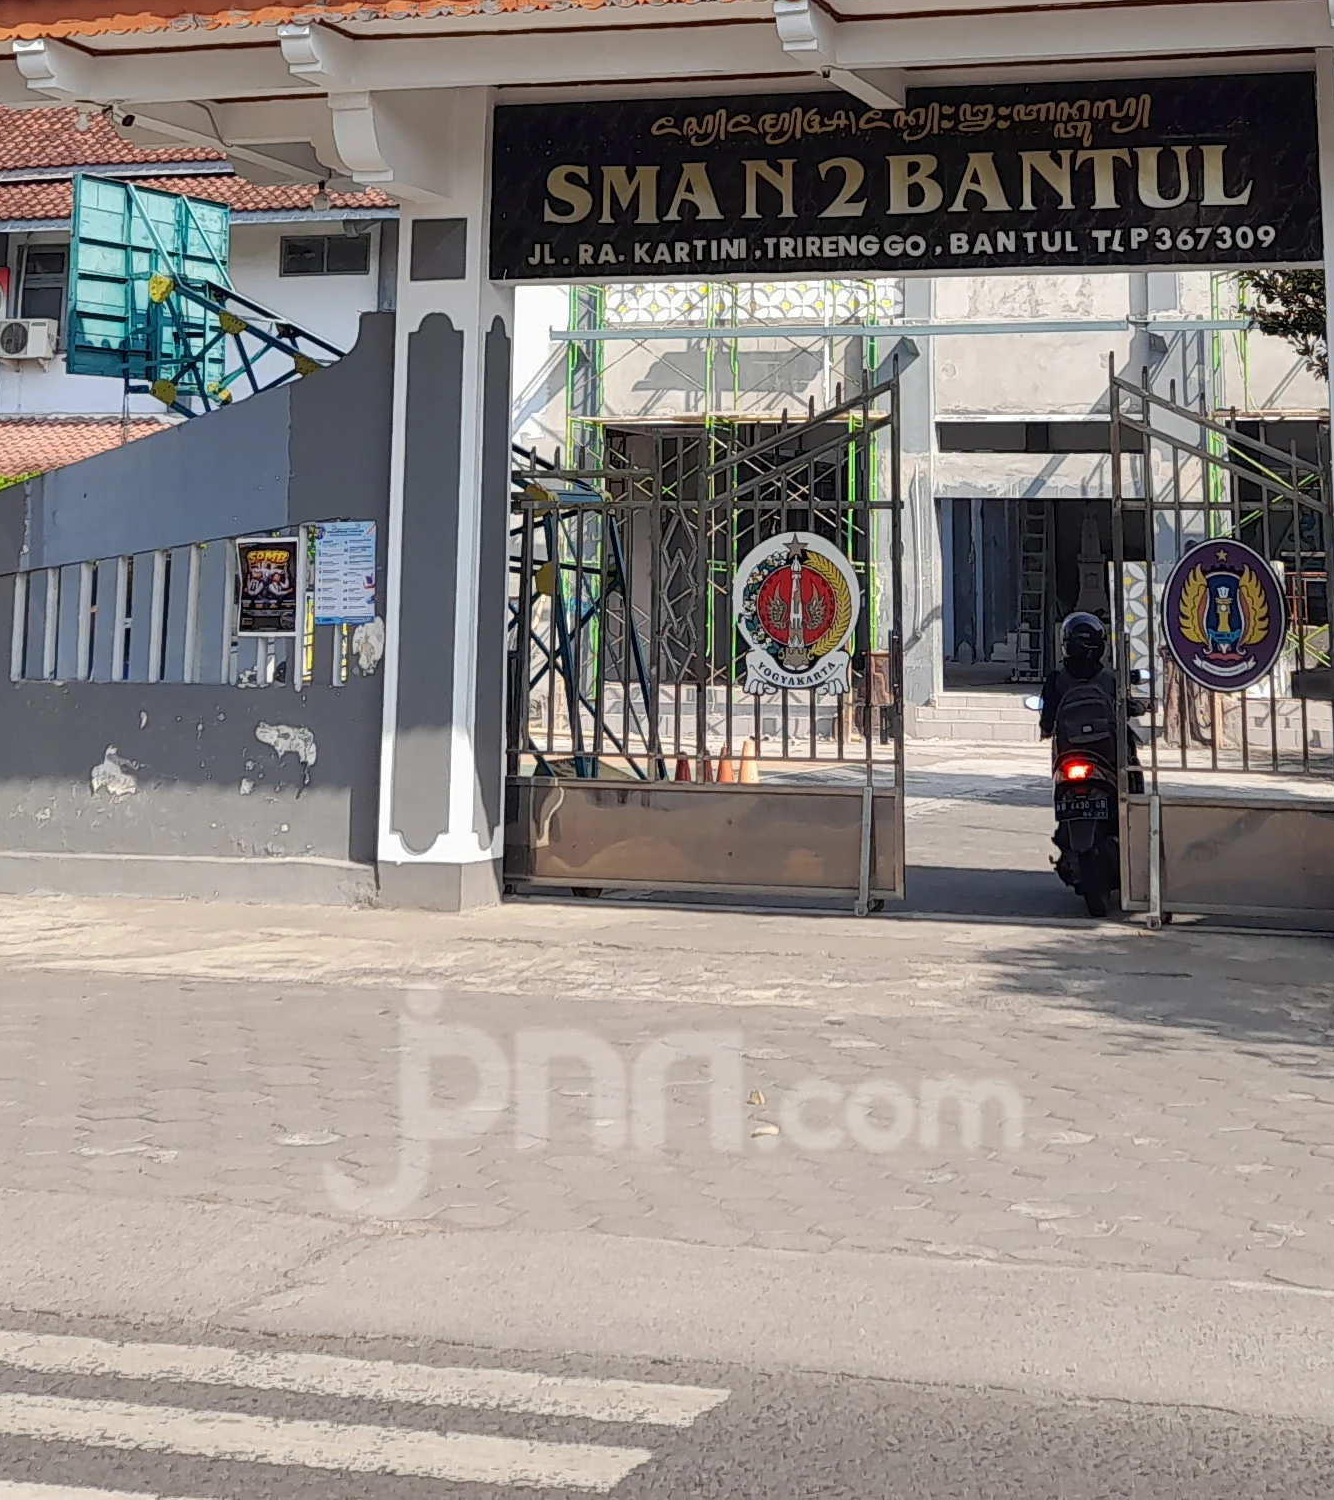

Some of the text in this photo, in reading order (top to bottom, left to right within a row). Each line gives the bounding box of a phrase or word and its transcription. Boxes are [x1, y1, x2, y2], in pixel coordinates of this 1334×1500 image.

[542, 144, 1254, 225] SMA N 2 BANTUL
[578, 242, 626, 266] RA.
[758, 661, 836, 686] YOGYAKARTA
